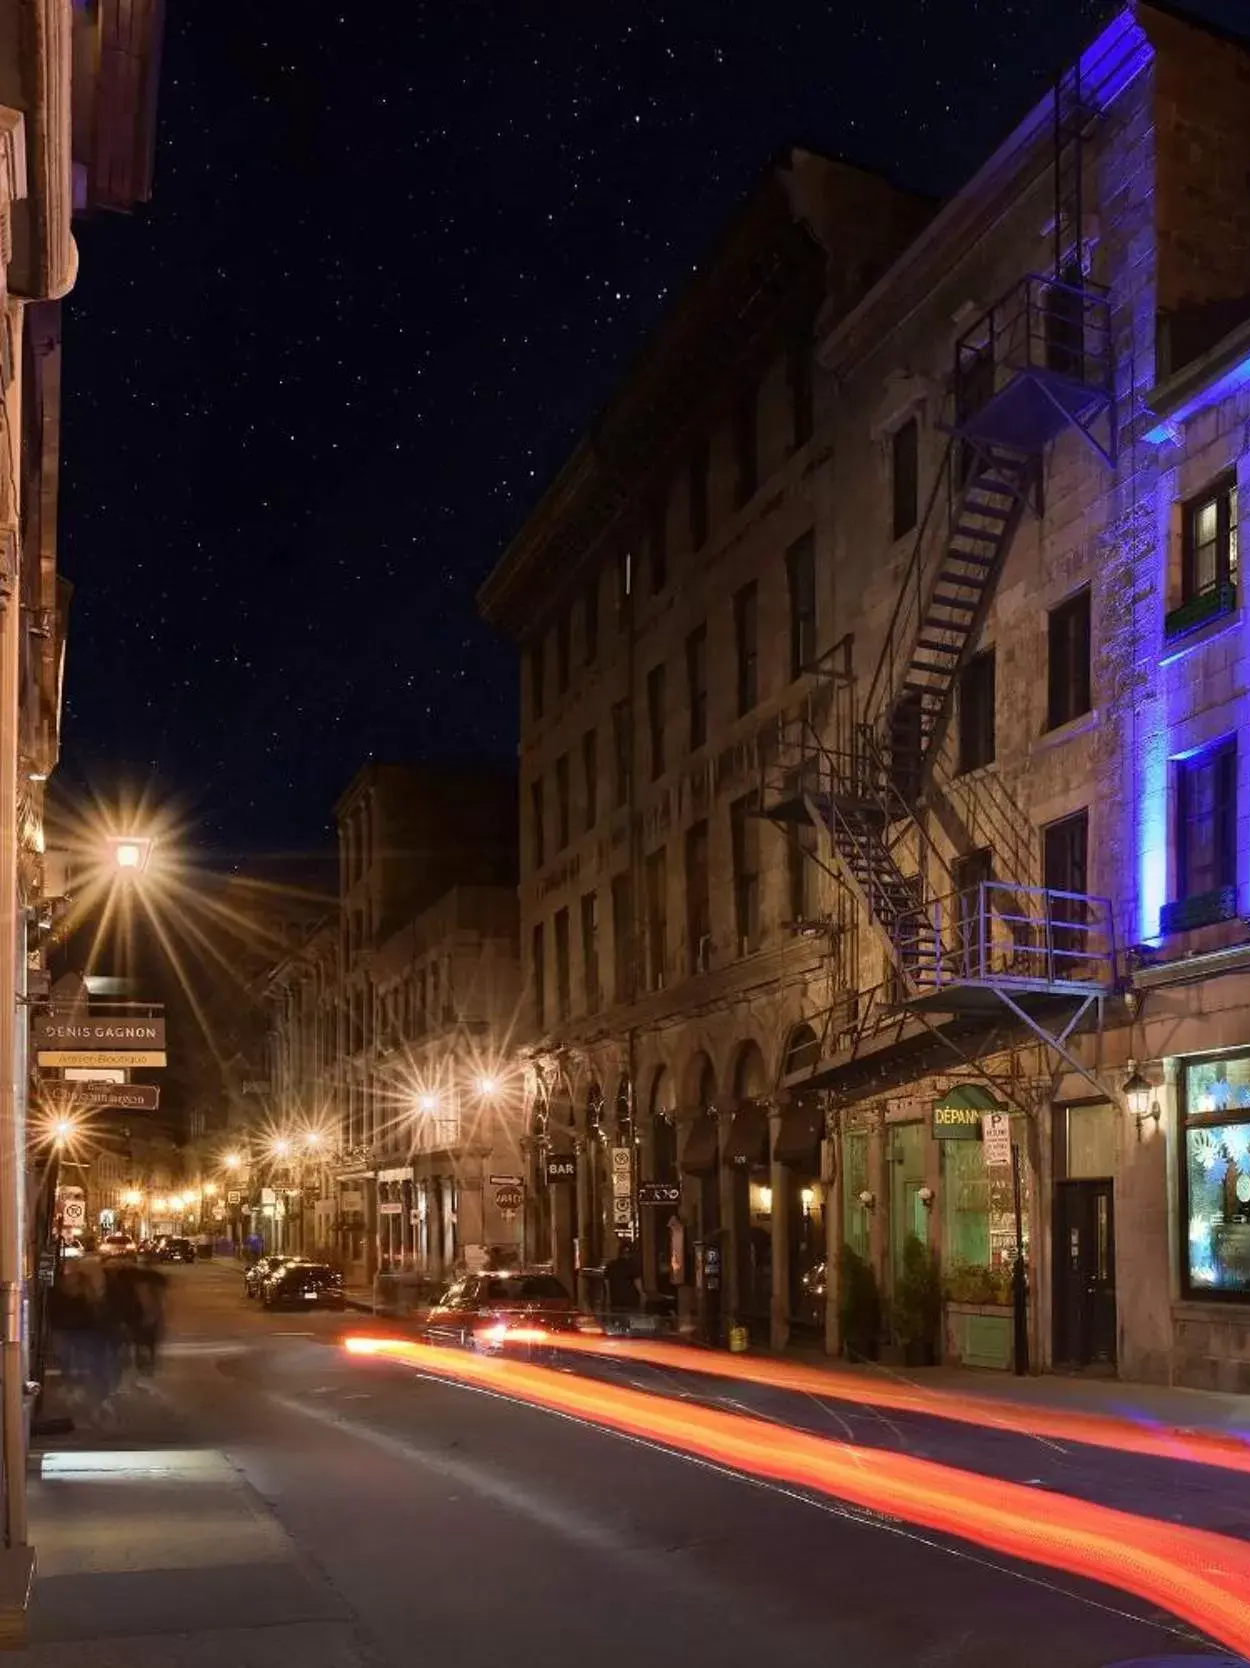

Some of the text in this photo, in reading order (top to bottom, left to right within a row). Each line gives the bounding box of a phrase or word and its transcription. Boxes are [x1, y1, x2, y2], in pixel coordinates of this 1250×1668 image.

[46, 1026, 157, 1038] DENIS GAGNON
[549, 1164, 574, 1175] BAR
